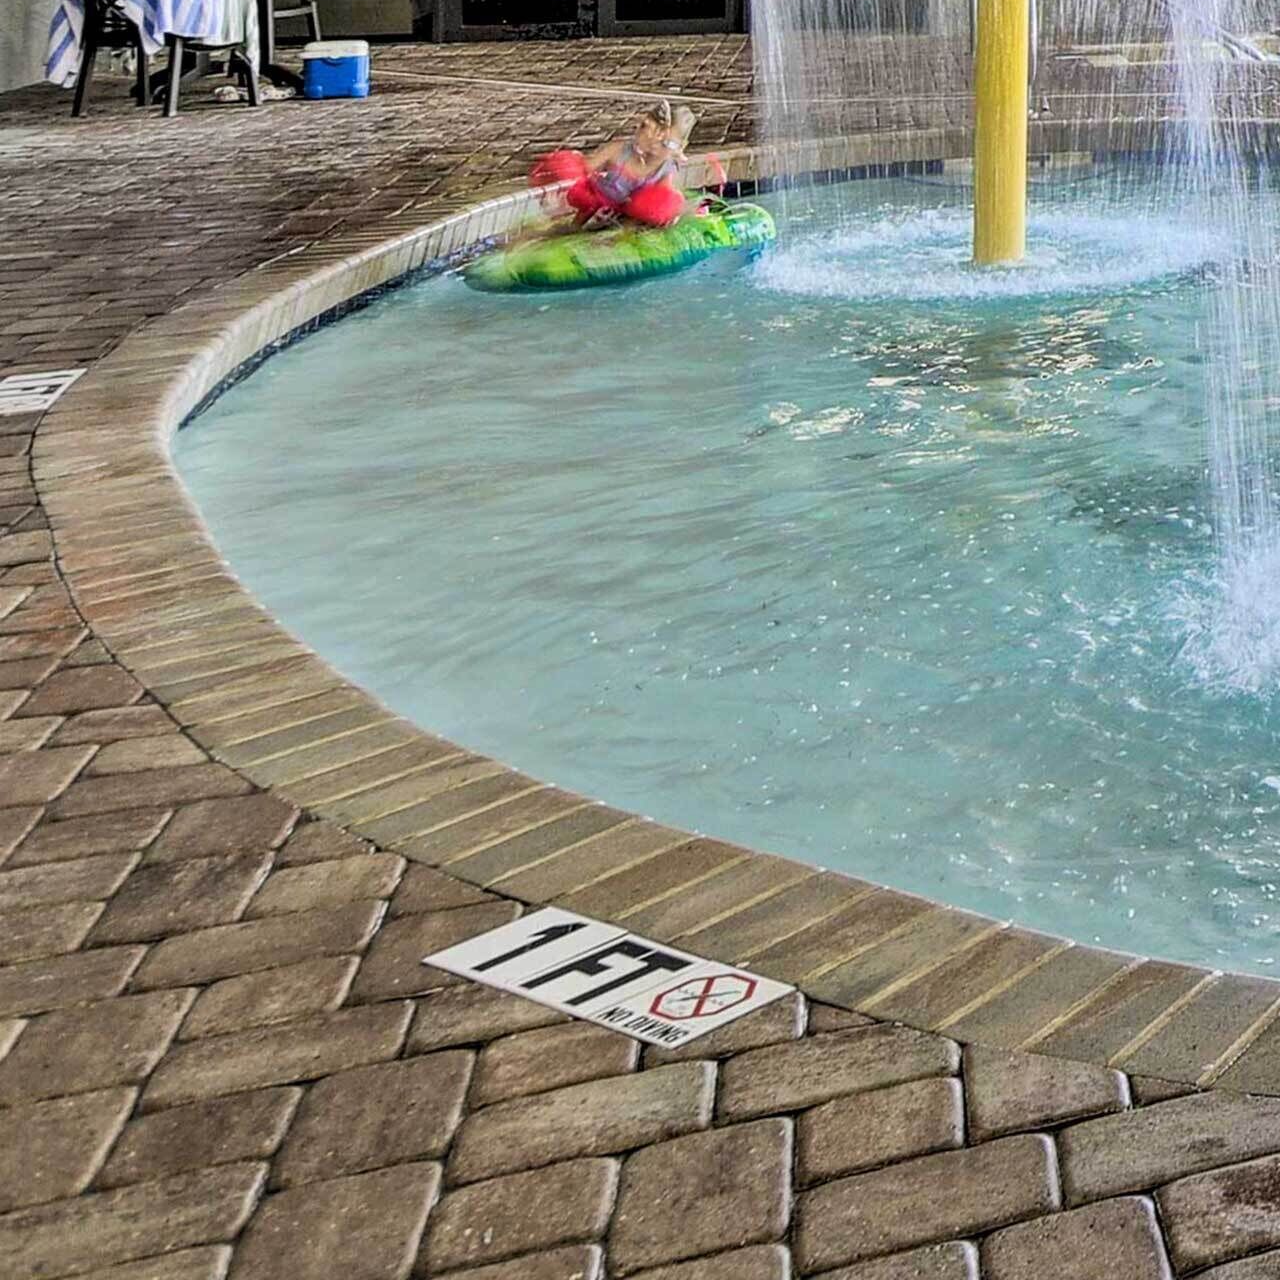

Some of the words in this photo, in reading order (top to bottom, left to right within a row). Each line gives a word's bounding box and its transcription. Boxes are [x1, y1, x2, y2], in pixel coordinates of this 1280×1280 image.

[471, 922, 589, 971] 1
[520, 940, 693, 1006] FT
[597, 1007, 634, 1023] NO
[623, 1015, 689, 1043] DIVING
